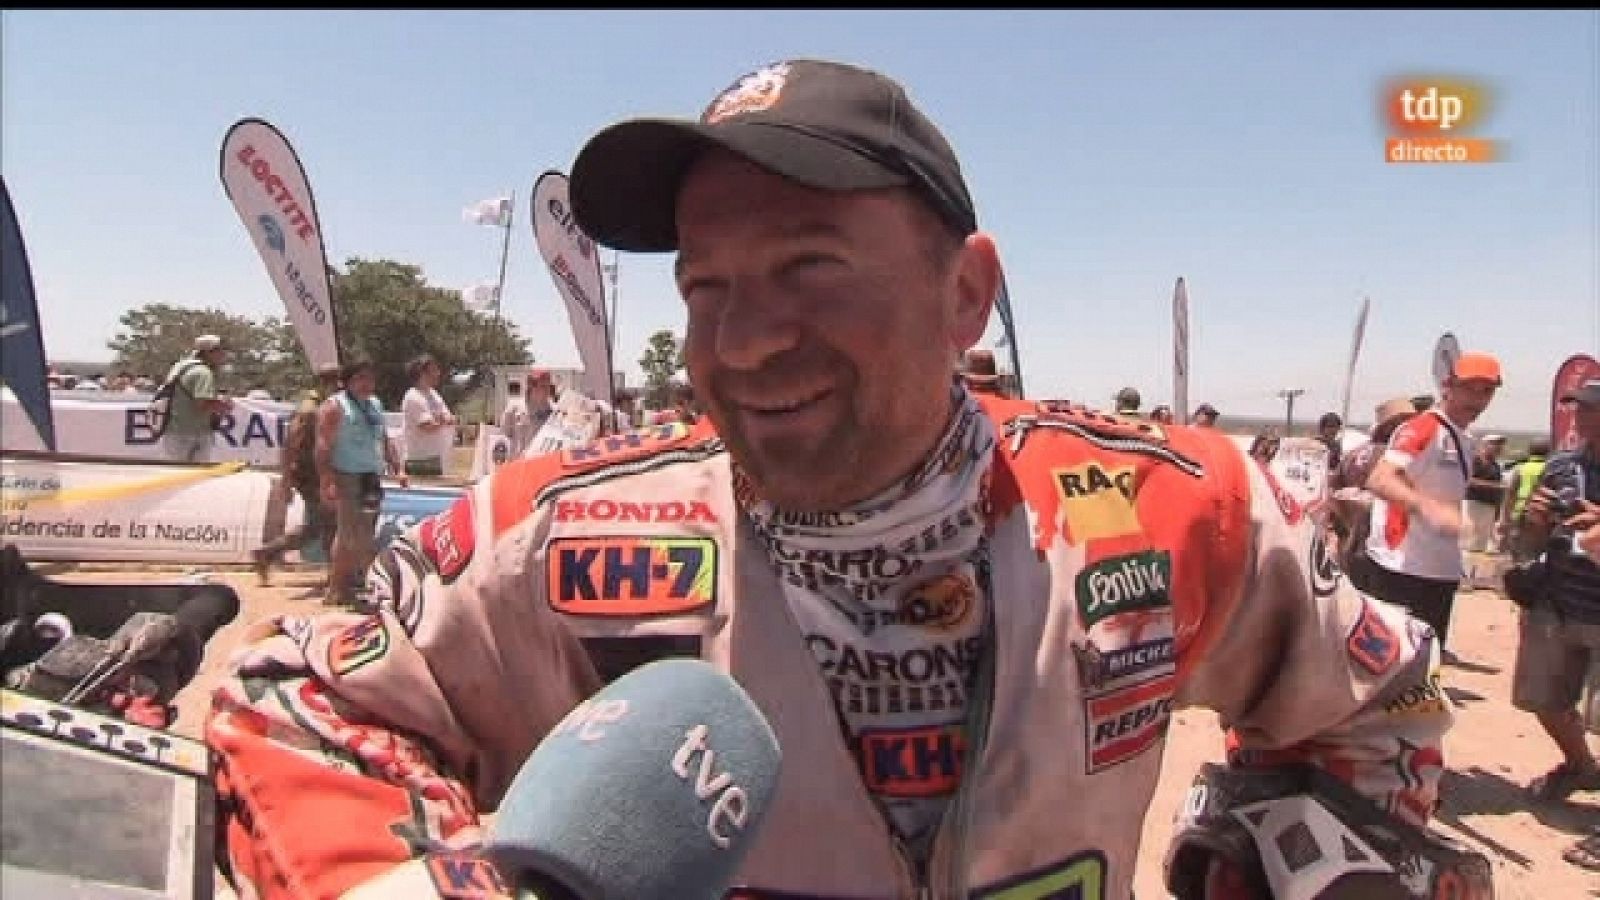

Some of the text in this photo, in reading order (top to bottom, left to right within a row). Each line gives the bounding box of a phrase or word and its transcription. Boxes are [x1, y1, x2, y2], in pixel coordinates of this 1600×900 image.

[237, 144, 315, 241] LOCTITE
[92, 519, 122, 539] de
[130, 519, 147, 539] la
[154, 522, 229, 544] Nación
[554, 500, 718, 523] HONDA
[559, 546, 706, 601] KH-7
[670, 723, 749, 850] tve
